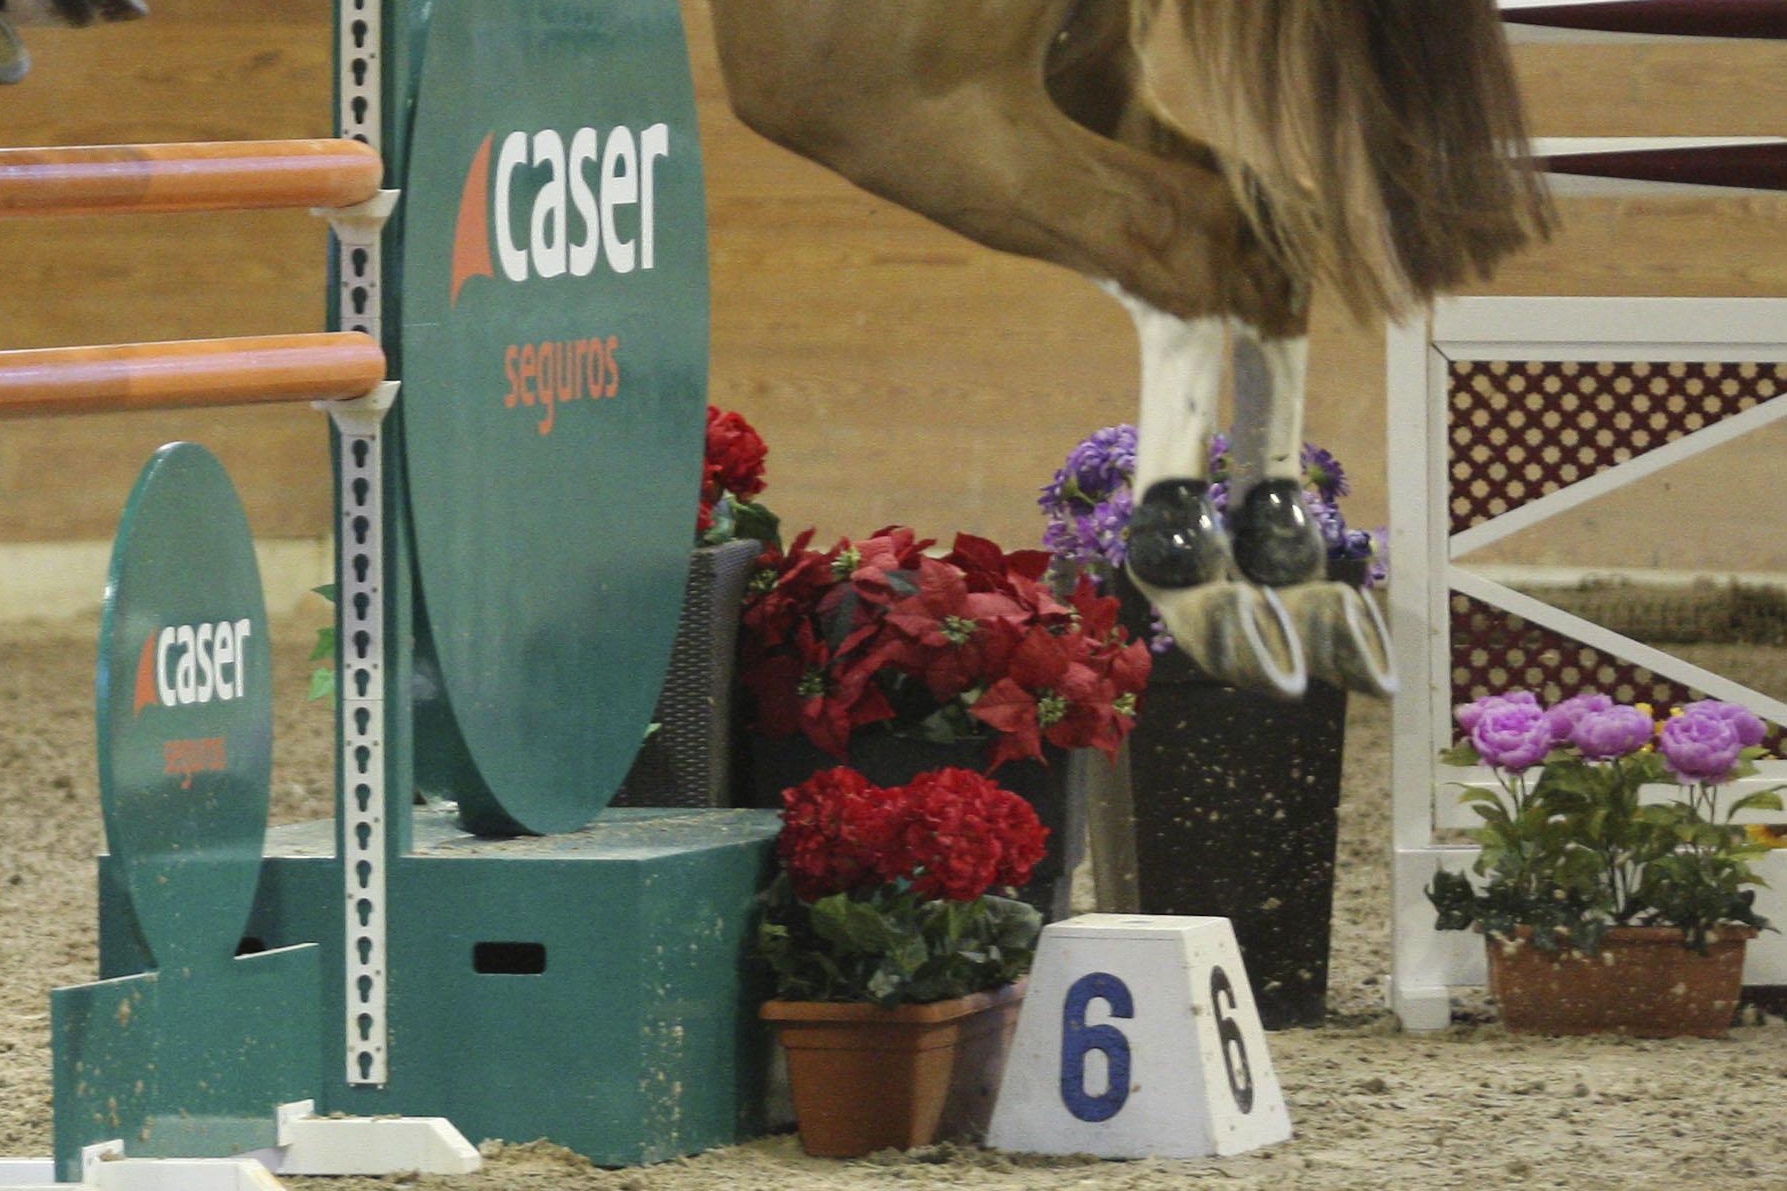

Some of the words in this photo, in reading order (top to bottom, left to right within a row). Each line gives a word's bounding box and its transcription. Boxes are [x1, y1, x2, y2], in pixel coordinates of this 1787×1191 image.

[494, 122, 669, 283] caser
[503, 335, 621, 436] seguros
[157, 618, 252, 707] caser
[1059, 971, 1135, 1124] 6
[1210, 964, 1254, 1115] 6
